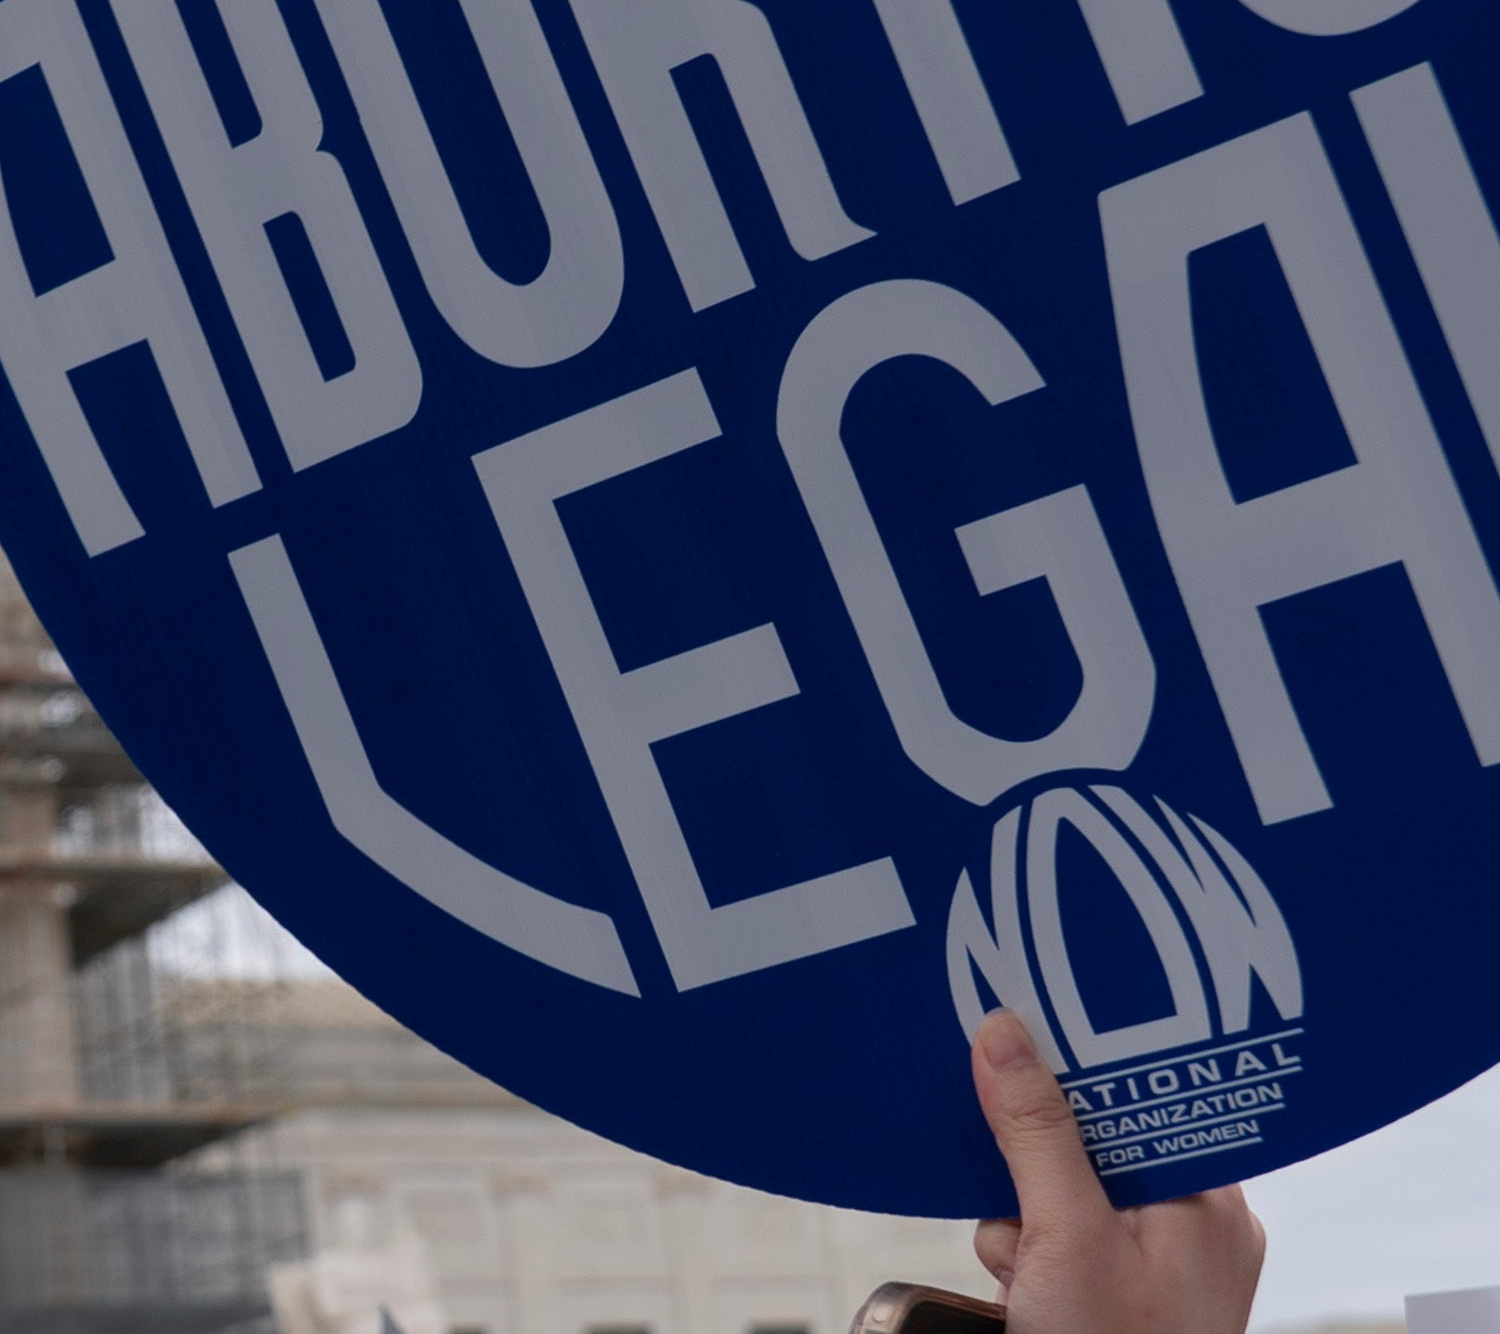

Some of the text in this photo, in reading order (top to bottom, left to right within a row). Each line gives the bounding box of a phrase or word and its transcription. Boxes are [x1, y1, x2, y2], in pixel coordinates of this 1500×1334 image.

[945, 783, 1304, 1074] NOW
[1067, 1042, 1302, 1112] ATIONAL
[1080, 1081, 1285, 1142] RGANIZATION
[1095, 1119, 1260, 1167] FOR WOMEN
